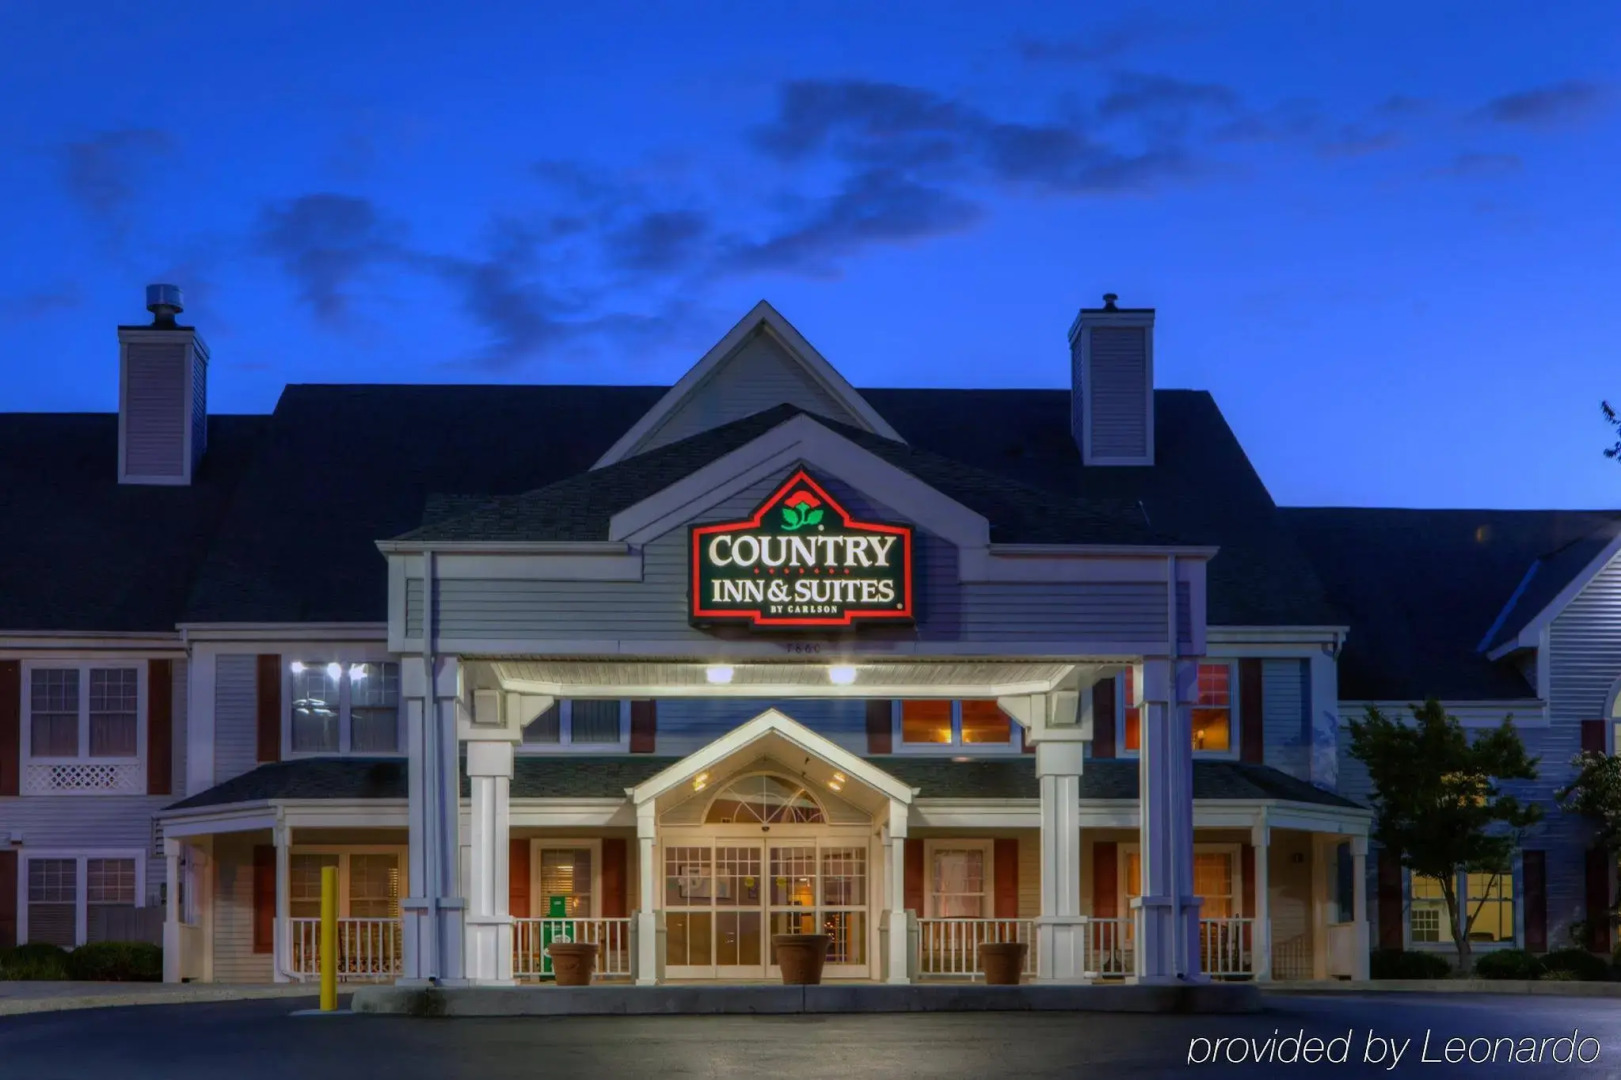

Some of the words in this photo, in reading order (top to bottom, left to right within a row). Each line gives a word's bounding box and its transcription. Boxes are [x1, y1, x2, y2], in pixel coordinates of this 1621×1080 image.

[708, 535, 897, 567] COUNTRY
[711, 579, 765, 602] INN
[767, 579, 792, 602] &
[794, 579, 895, 603] SUITES
[770, 605, 783, 613] BY
[787, 605, 838, 613] CARLSON
